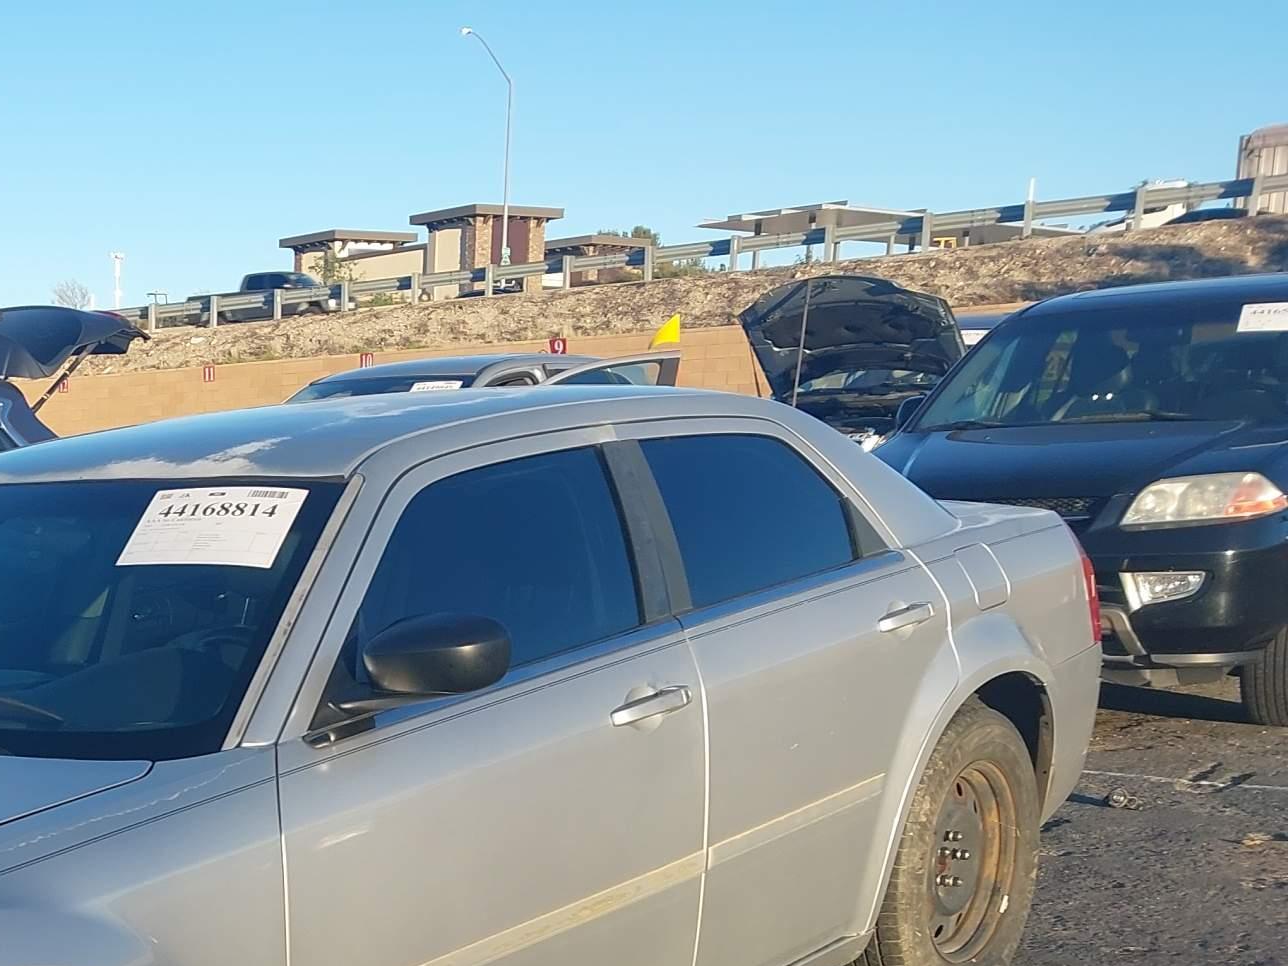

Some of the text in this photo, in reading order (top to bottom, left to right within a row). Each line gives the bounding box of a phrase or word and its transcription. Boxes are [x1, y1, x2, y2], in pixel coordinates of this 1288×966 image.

[554, 340, 563, 354] 9
[205, 367, 214, 381] 11
[158, 502, 279, 518] 44168814
